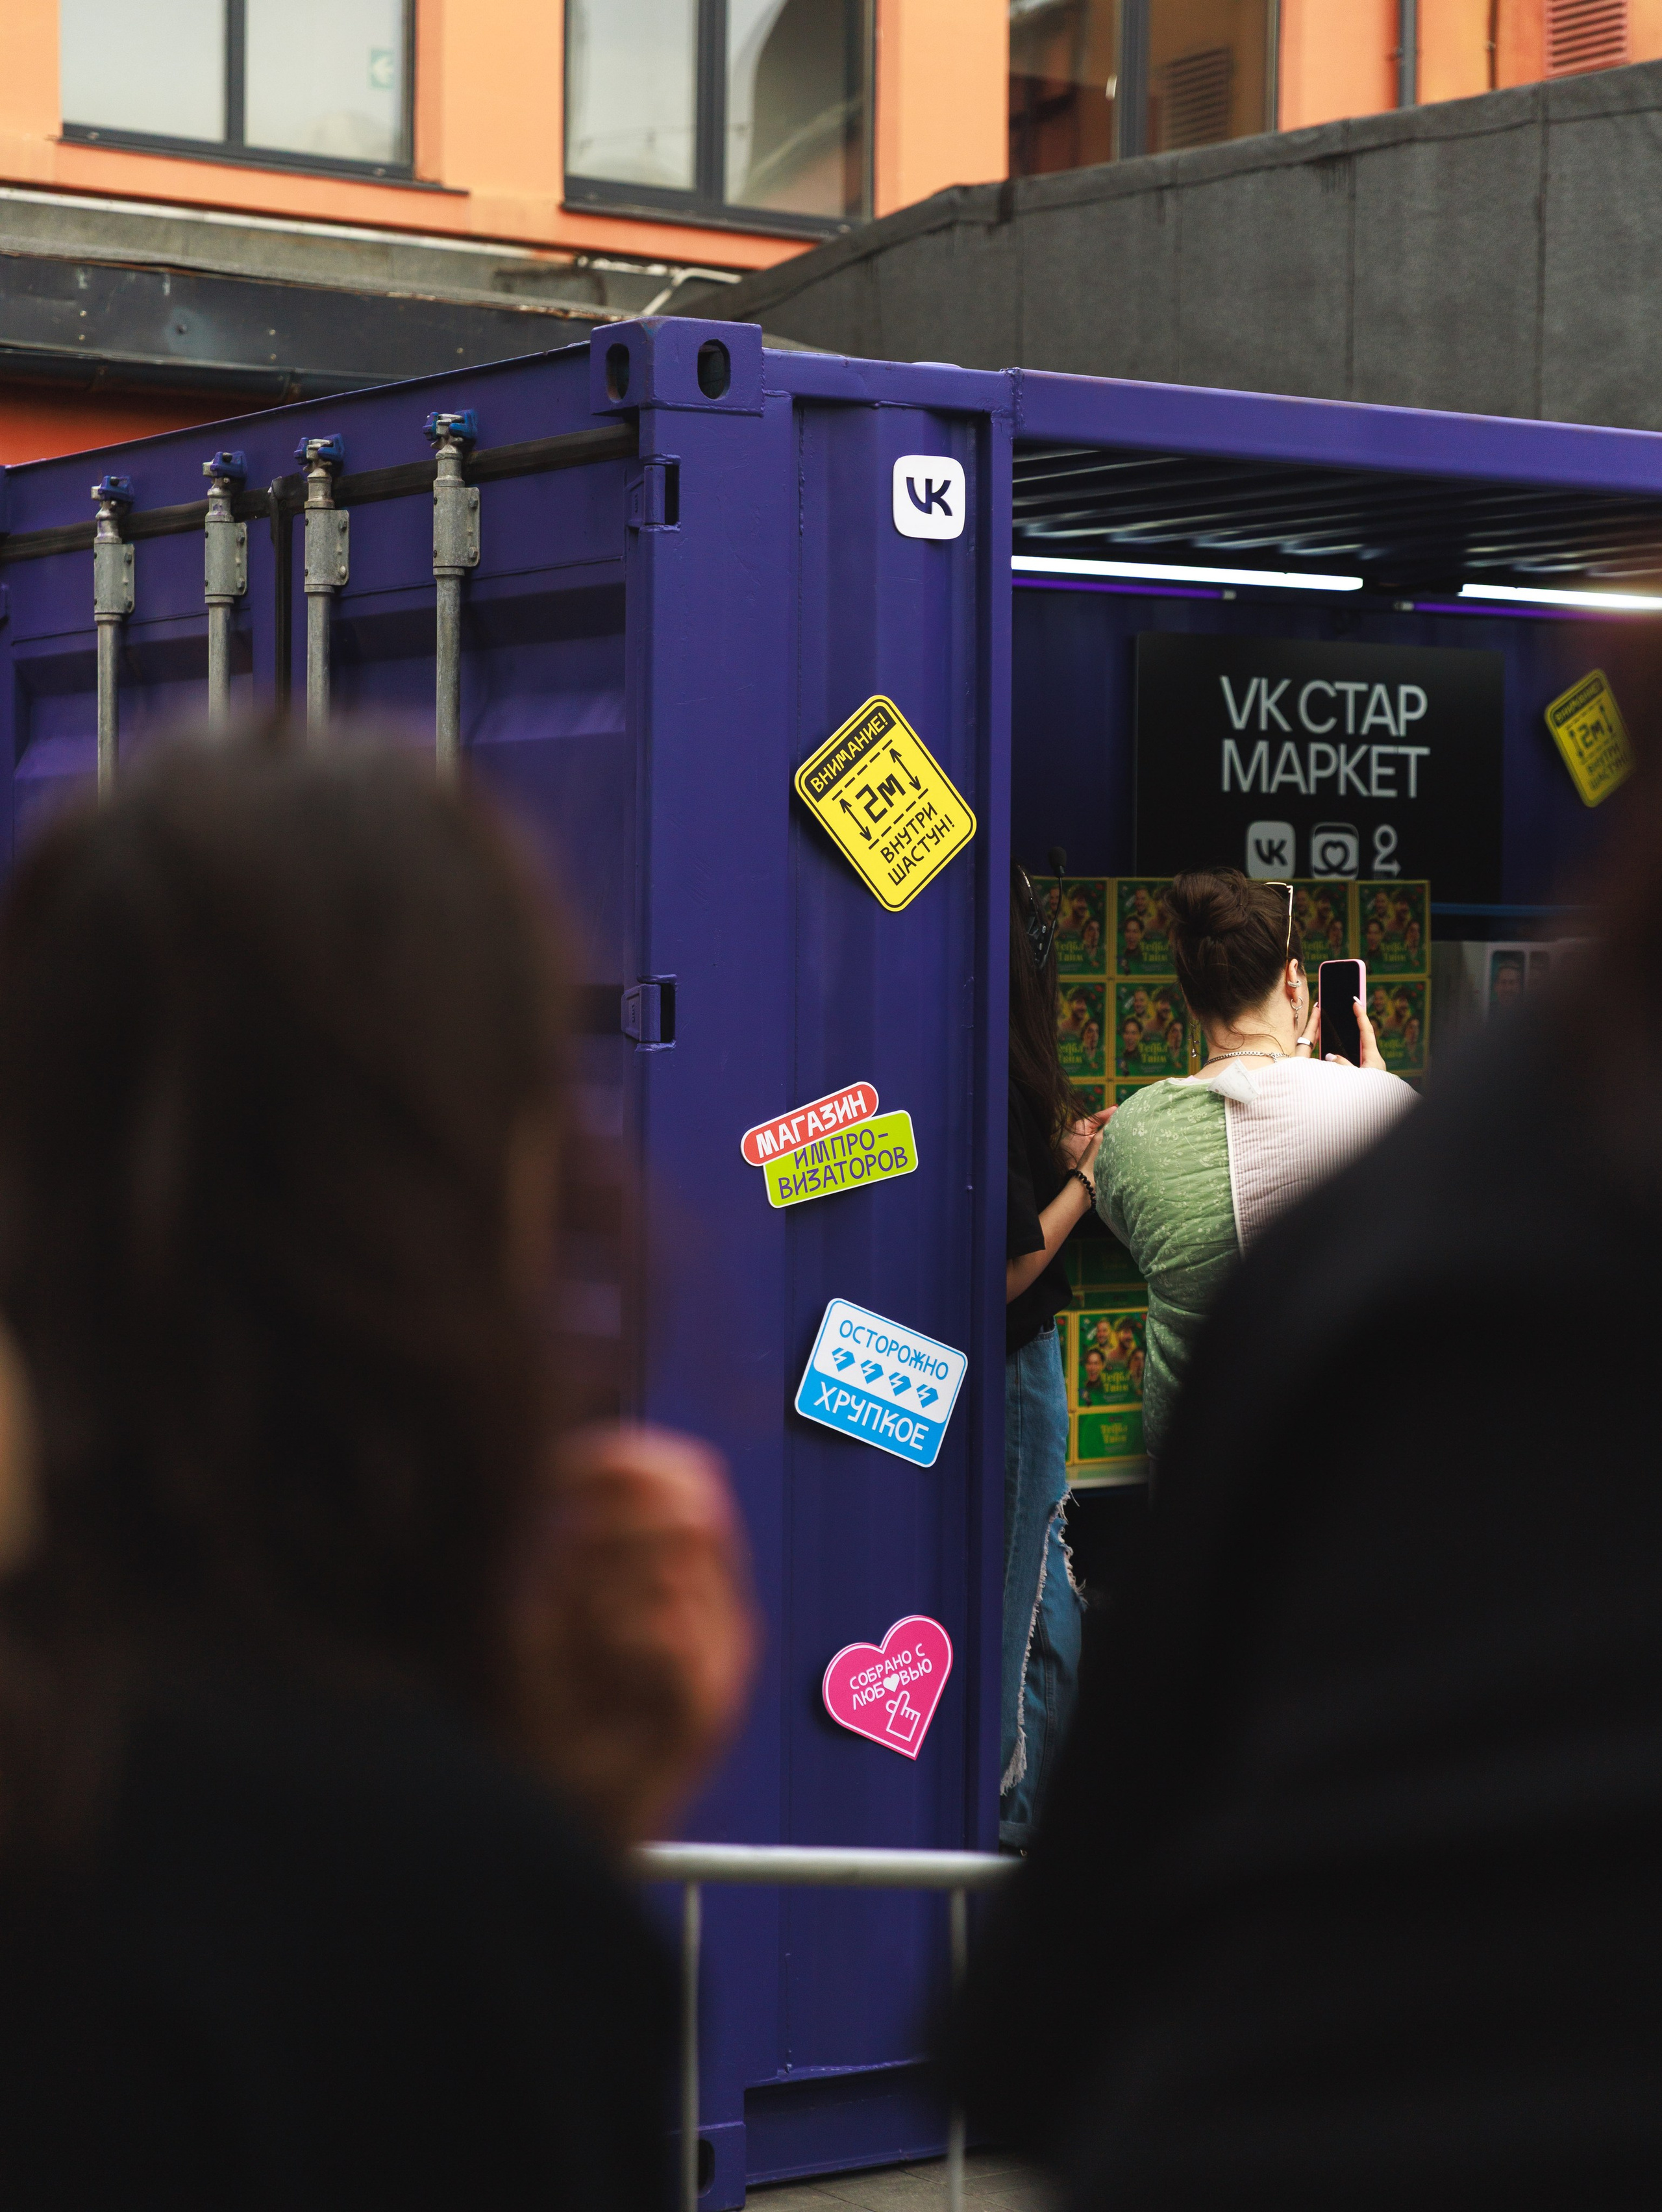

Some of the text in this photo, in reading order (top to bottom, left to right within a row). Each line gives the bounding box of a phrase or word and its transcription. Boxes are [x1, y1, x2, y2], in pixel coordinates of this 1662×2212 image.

[906, 477, 952, 516] VK
[1220, 675, 1428, 737] VK СТАР
[810, 712, 889, 793] ВНИМАНИЕ!
[1221, 738, 1431, 799] МАРКЕТ
[880, 801, 938, 864] ВНУТРИ
[887, 814, 956, 886] ШАСТУН!
[755, 1089, 867, 1159] МАГАЗИН
[793, 1128, 889, 1169] ИМПРО-
[778, 1146, 908, 1200] ВИЗАТОРОВ
[839, 1319, 949, 1380] ОСТОРОЖНО
[813, 1380, 930, 1451] ХРУПКОЕ
[849, 1650, 912, 1690] СОБРАНО
